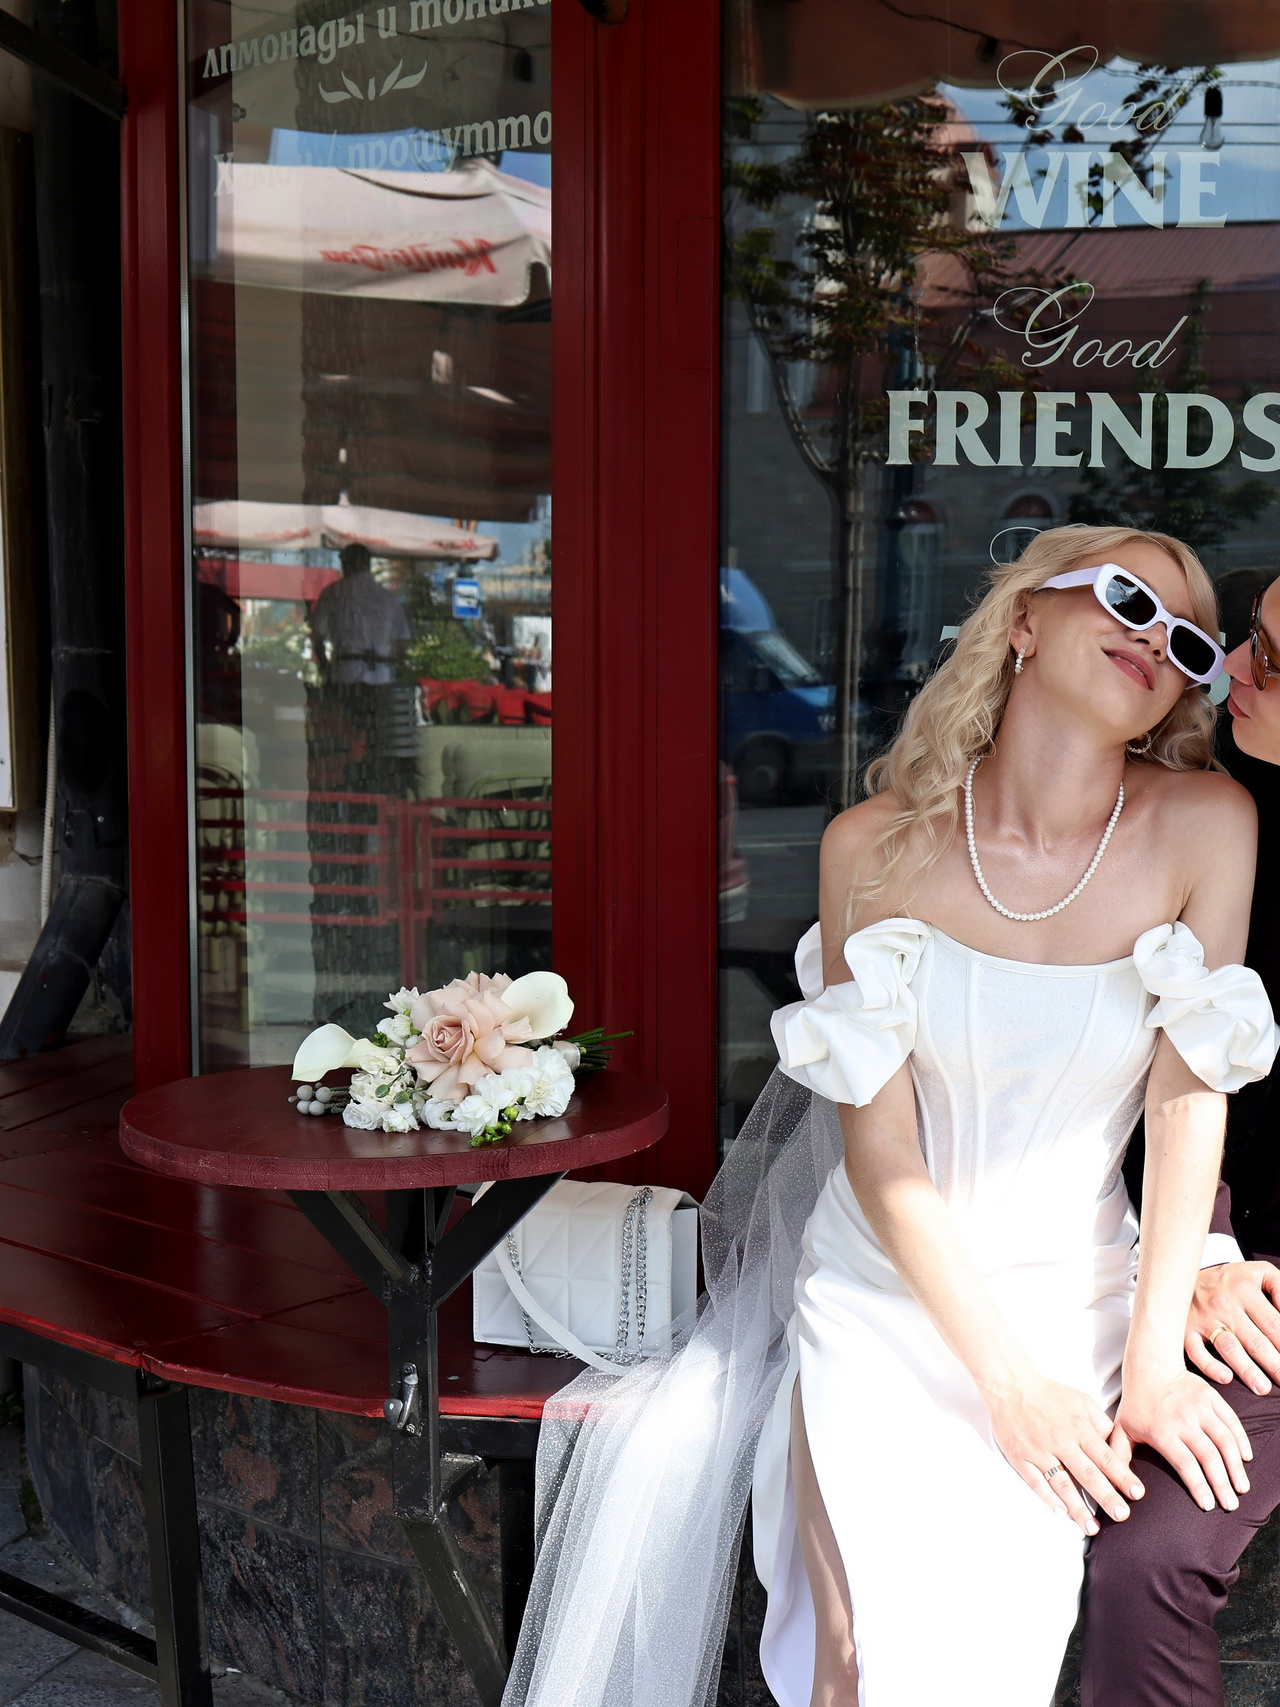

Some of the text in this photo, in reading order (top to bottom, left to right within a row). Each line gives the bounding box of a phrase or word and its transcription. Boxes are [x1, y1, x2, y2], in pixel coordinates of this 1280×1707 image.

[377, 6, 405, 40] и
[996, 45, 1194, 132] Good
[960, 151, 1229, 229] WINE
[993, 282, 1189, 368] Good
